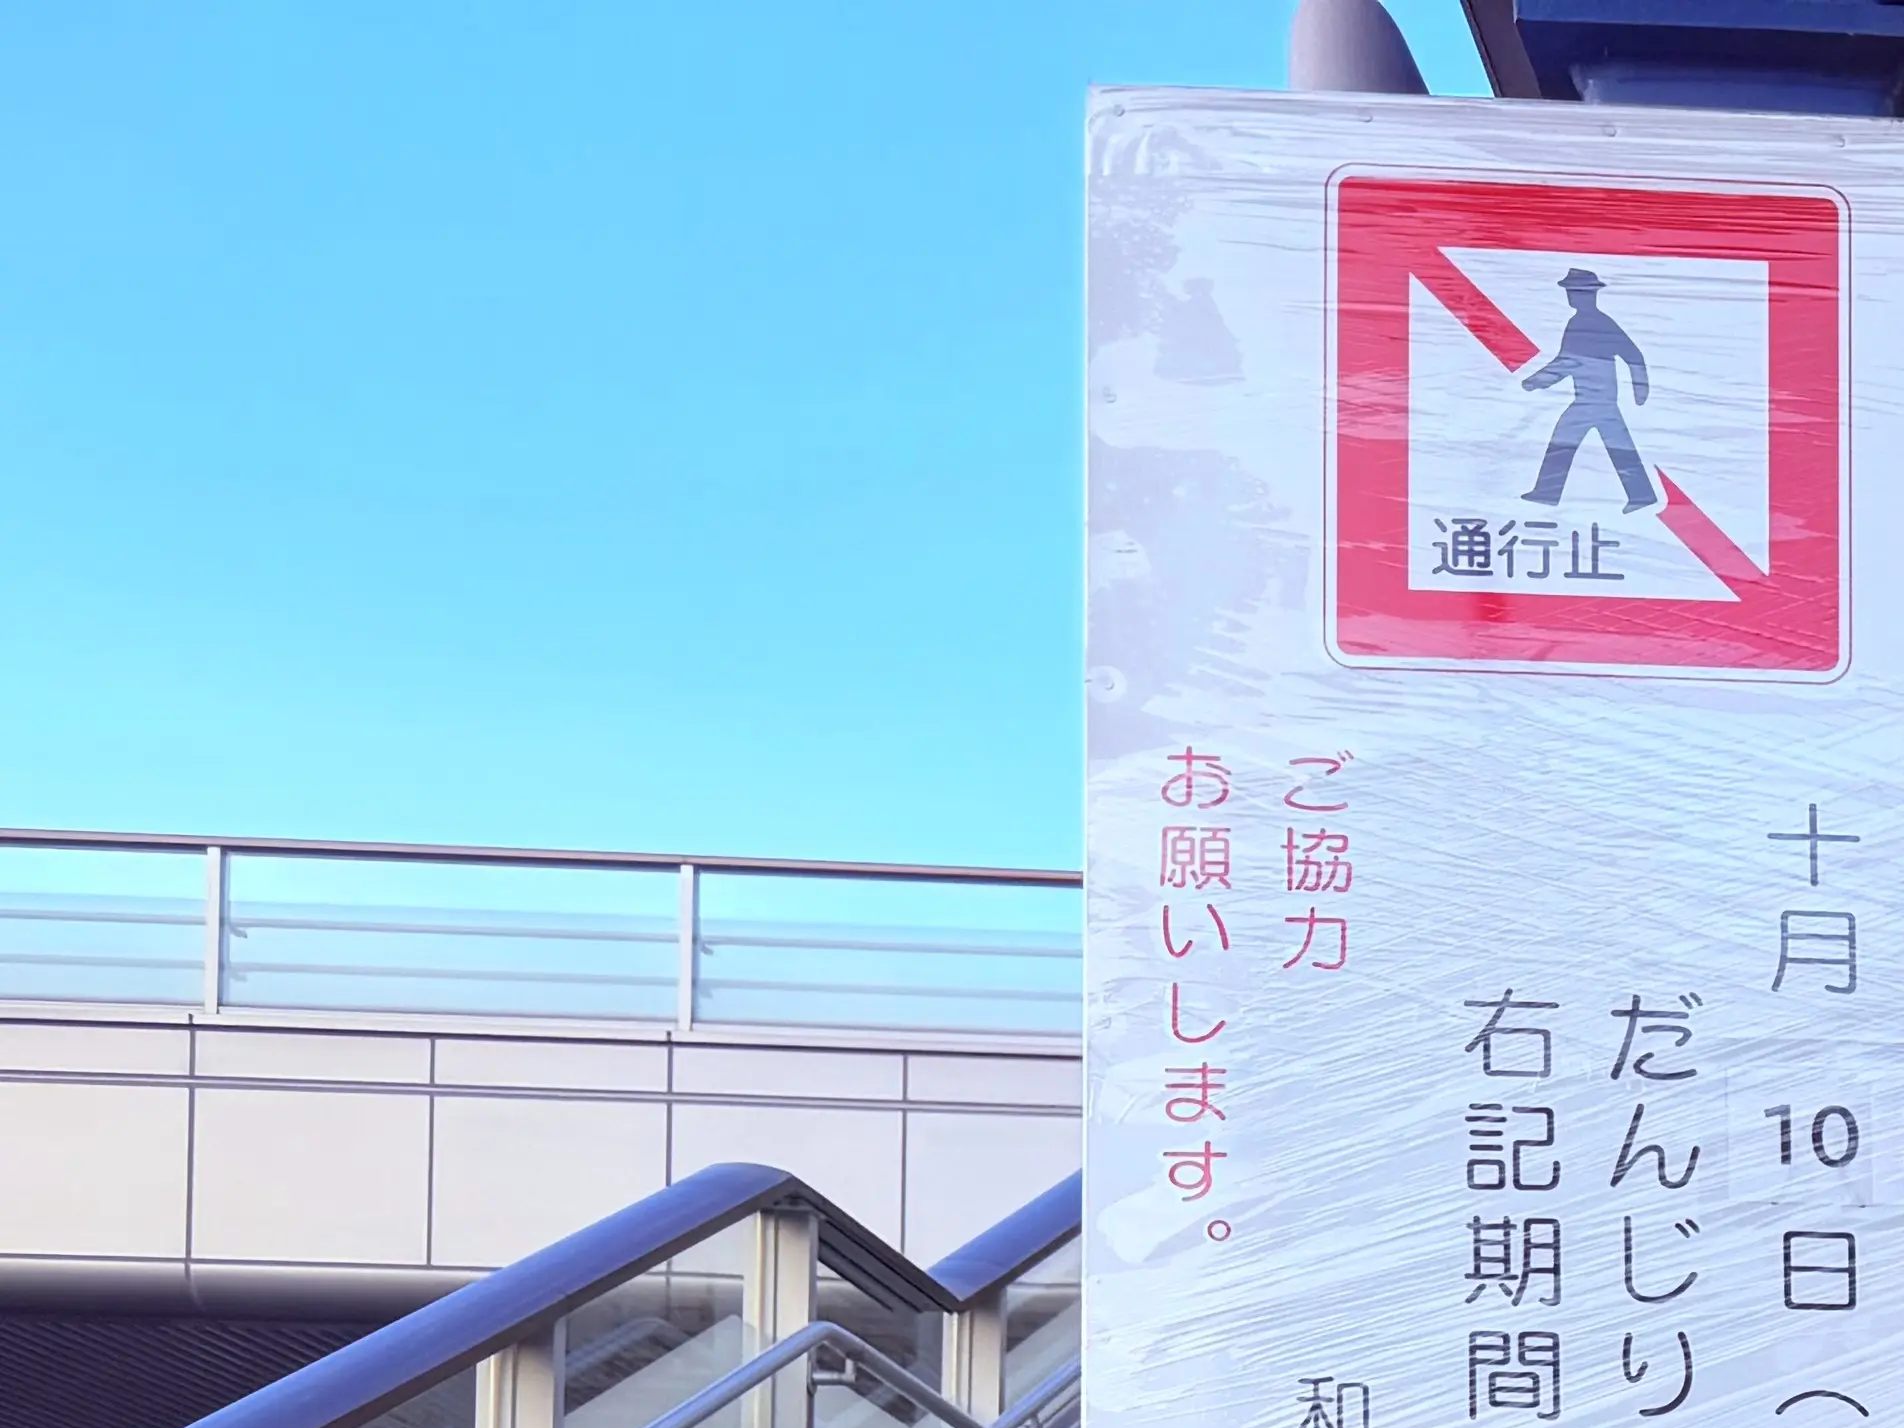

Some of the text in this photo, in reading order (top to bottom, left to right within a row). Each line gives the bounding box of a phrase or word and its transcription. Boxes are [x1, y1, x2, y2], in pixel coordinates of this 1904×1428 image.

[1430, 517, 1628, 583] 通行止
[1279, 749, 1356, 973] ご協力
[1158, 744, 1233, 1244] お願いします。
